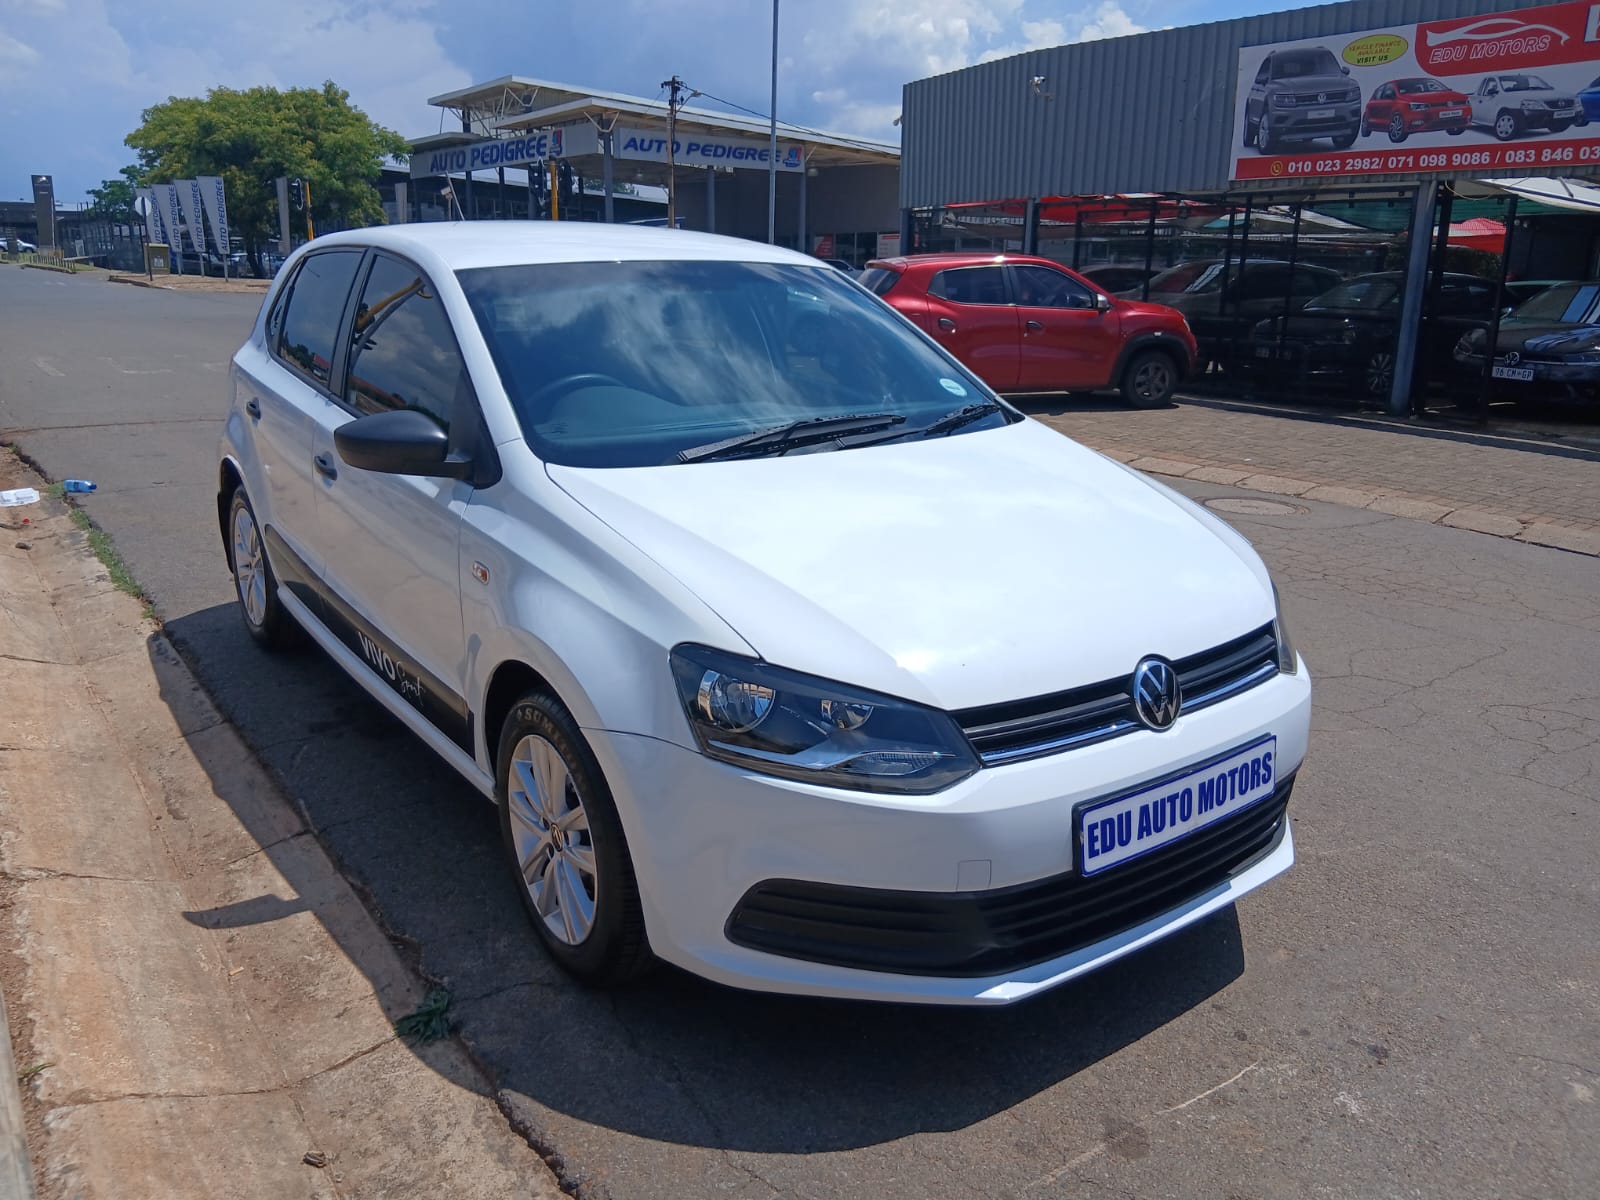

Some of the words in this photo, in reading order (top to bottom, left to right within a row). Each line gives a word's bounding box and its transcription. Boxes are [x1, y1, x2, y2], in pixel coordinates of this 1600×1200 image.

[1357, 56, 1375, 64] VISIT
[1378, 54, 1389, 62] US
[1429, 45, 1467, 64] EDU
[1470, 35, 1551, 59] MOTORS
[430, 150, 467, 173] AUTO
[470, 134, 548, 167] PEDIGREE
[624, 137, 681, 155] AUTO
[1287, 161, 1312, 173] 010
[1315, 159, 1341, 172] 023
[1387, 155, 1414, 169] 071
[1419, 154, 1447, 167] 098
[1451, 151, 1491, 166] 9086
[1505, 149, 1536, 163] 083
[1541, 147, 1574, 162] 846
[169, 184, 179, 226] PEDIGREE
[191, 181, 201, 225] PEDIGREE
[215, 178, 226, 225] PEDIGREE
[173, 228, 181, 250] AUTO
[196, 226, 204, 249] AUTO
[220, 226, 229, 251] AUTO
[358, 631, 396, 681] VIVO
[1087, 810, 1132, 859] EDU
[1137, 787, 1193, 841] AUTO
[1197, 751, 1273, 816] MOTORS
